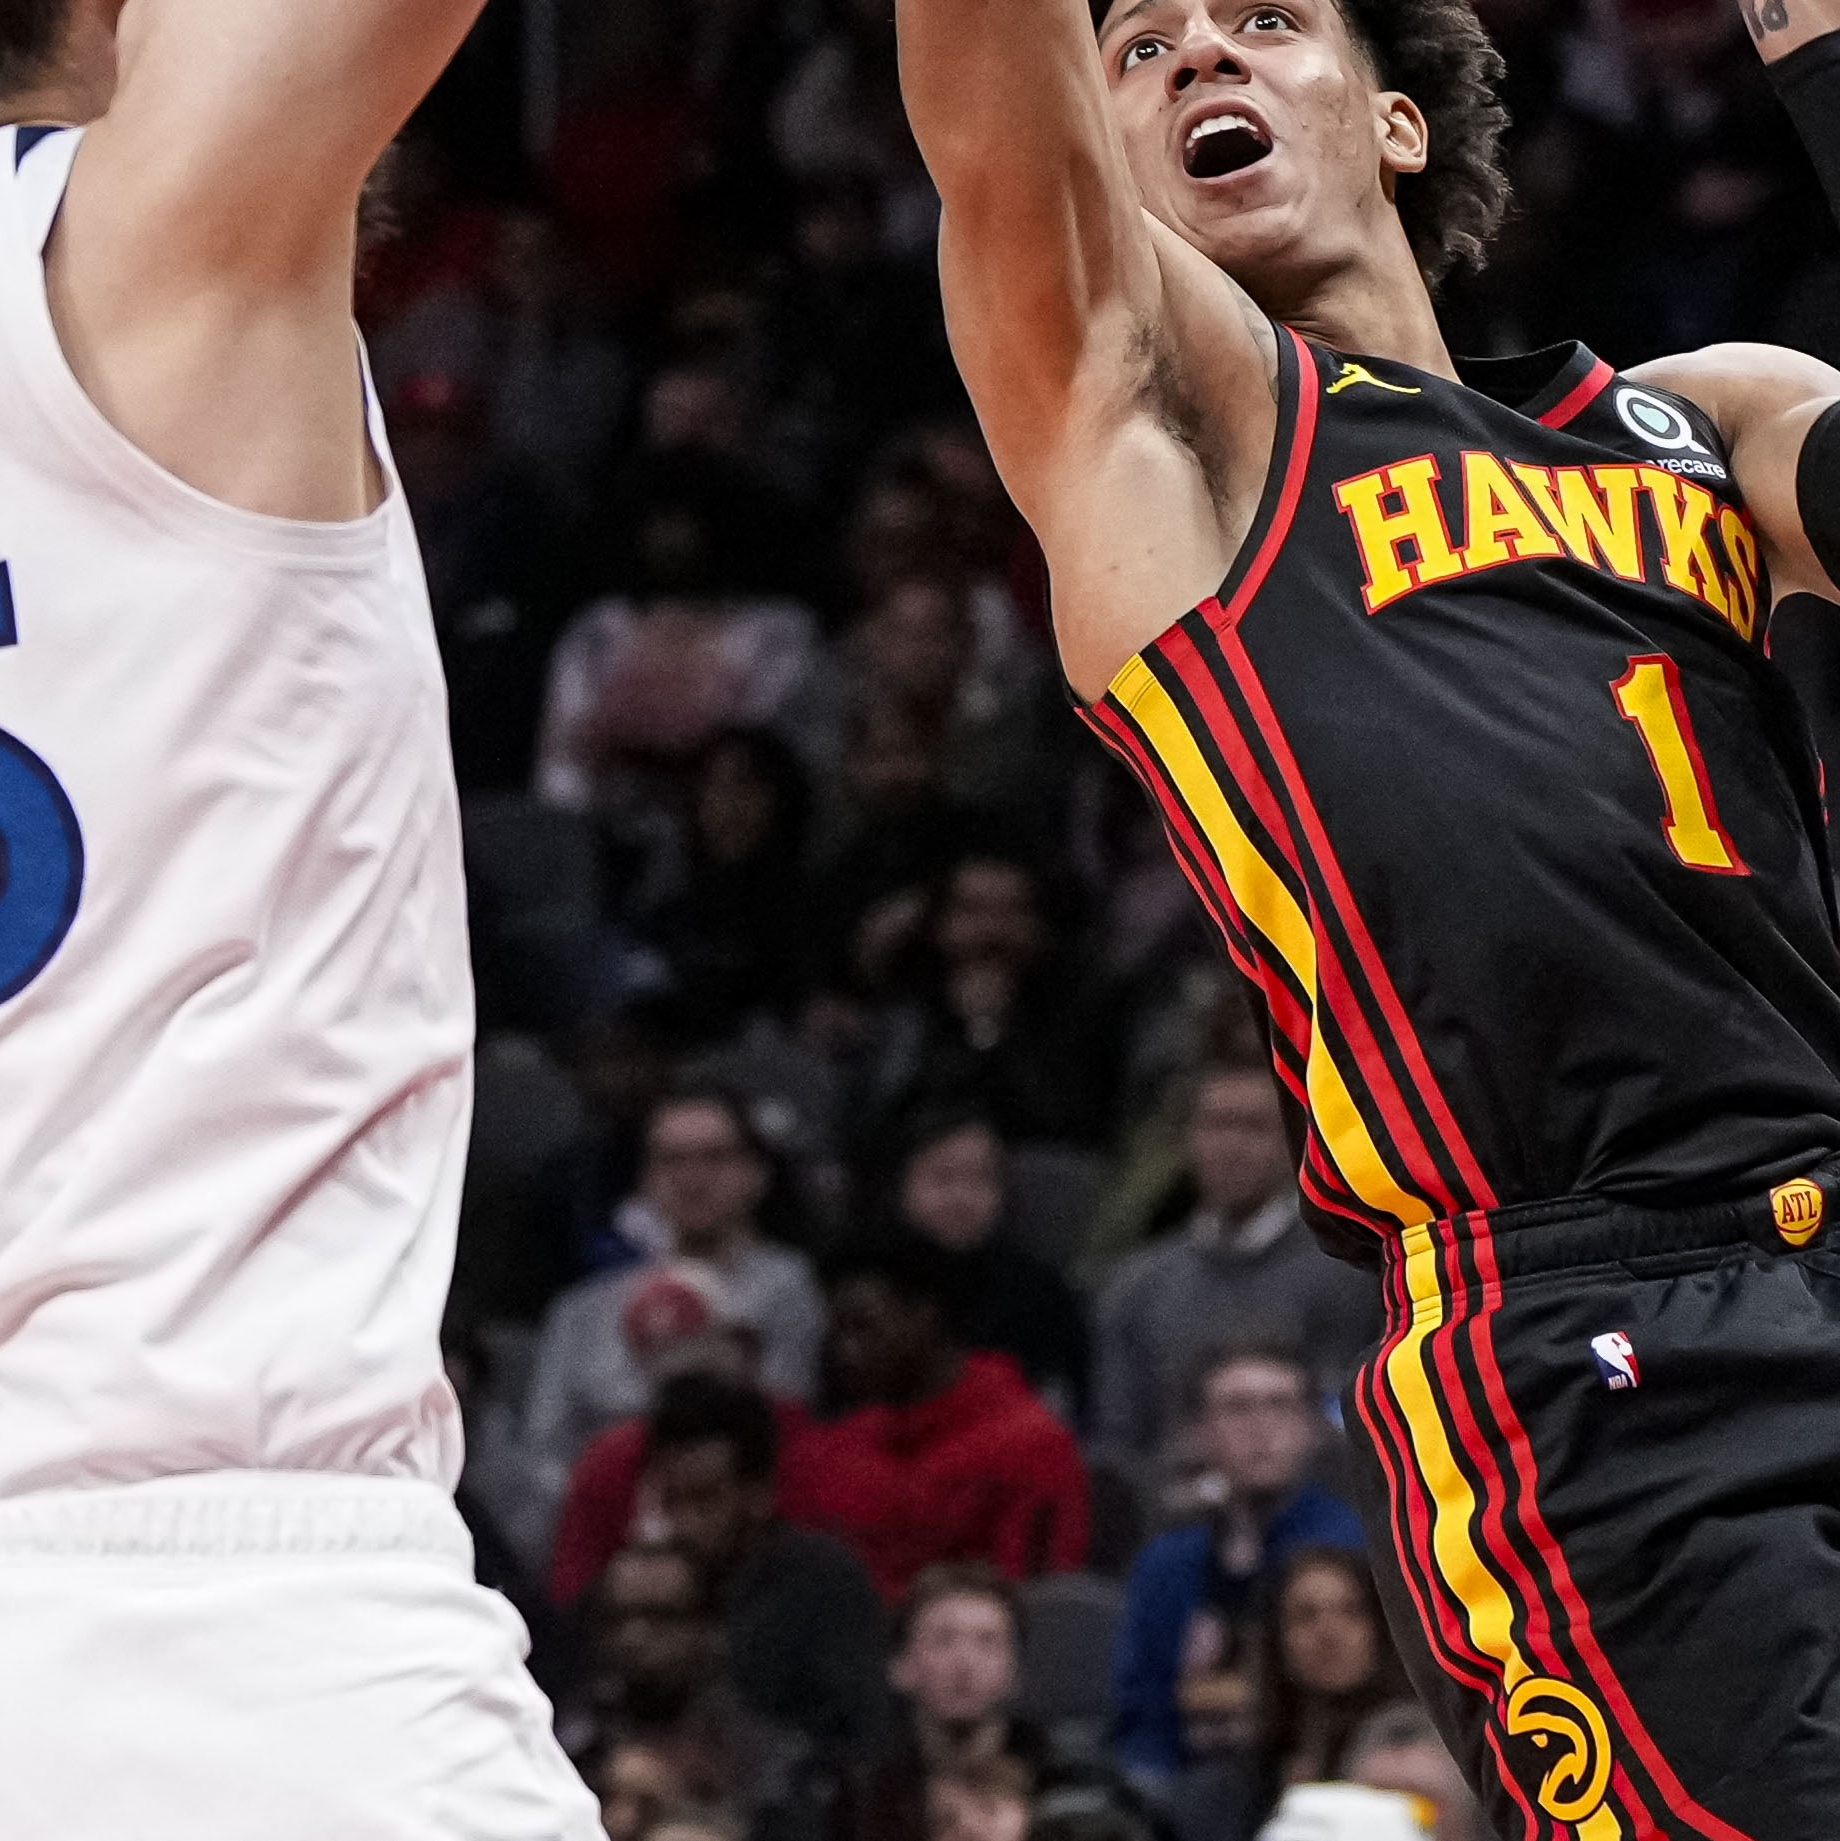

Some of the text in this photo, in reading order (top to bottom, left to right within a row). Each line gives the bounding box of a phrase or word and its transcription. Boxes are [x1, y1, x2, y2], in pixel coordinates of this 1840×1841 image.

[1331, 450, 1759, 644] HAWKS
[1609, 652, 1753, 877] 1
[1781, 1190, 1818, 1224] ATL
